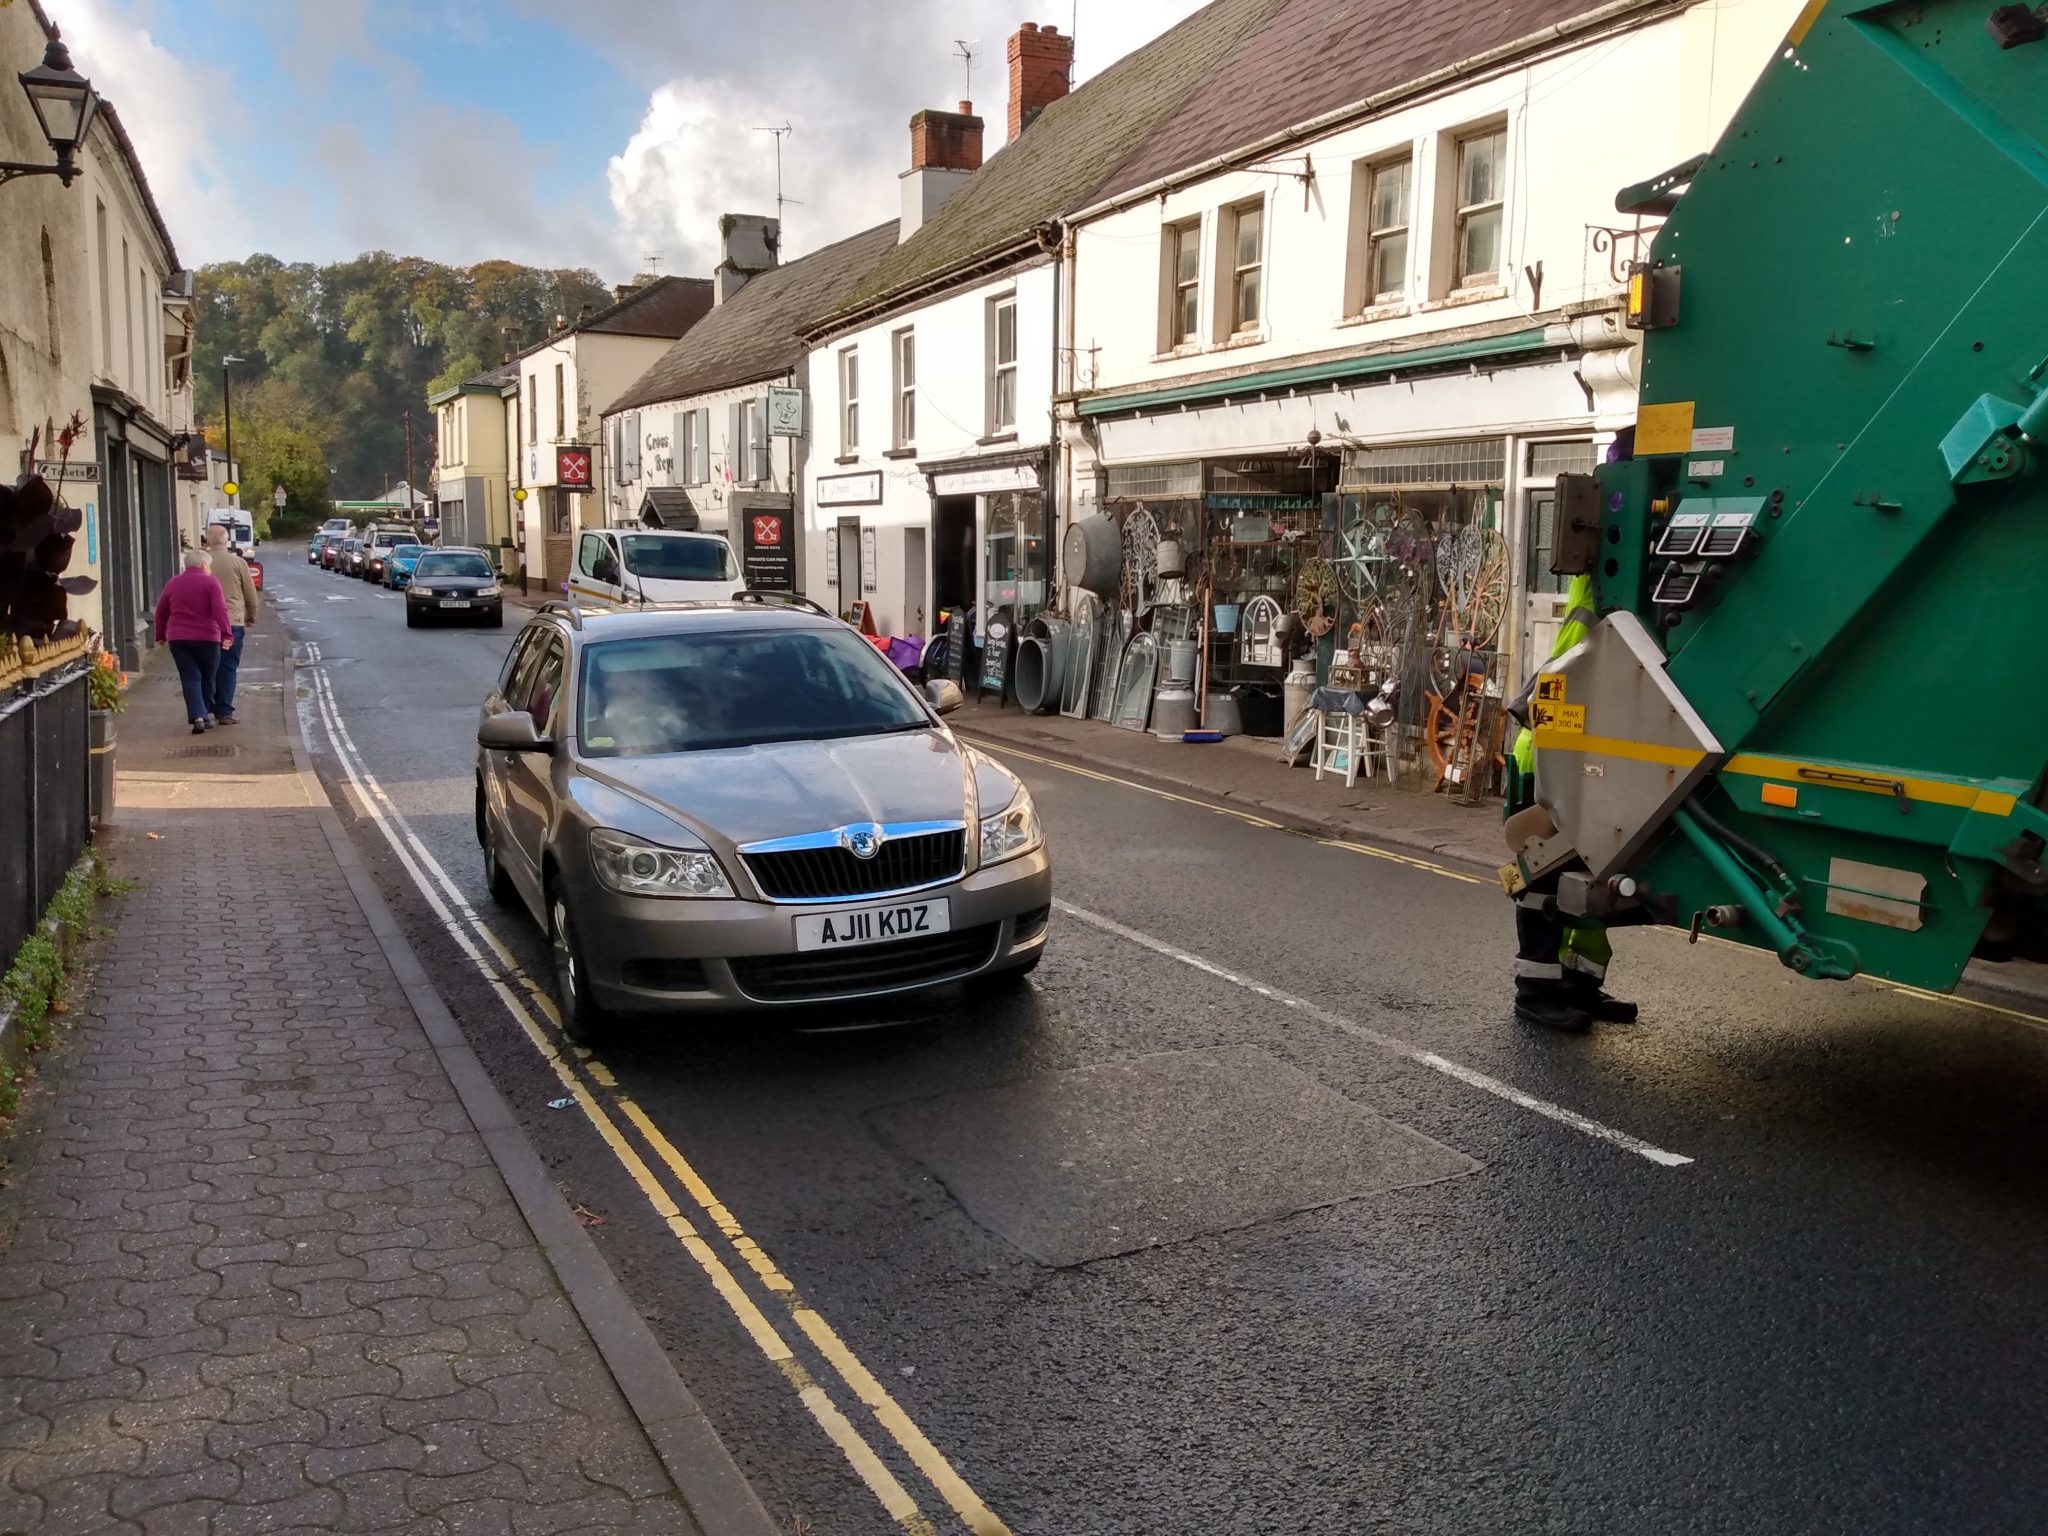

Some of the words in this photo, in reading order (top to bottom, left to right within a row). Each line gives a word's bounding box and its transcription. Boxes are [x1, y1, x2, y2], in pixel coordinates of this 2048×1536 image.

[50, 467, 86, 477] Tolets
[1562, 710, 1580, 718] MAX
[1557, 720, 1572, 728] 300
[821, 913, 872, 944] AJ11
[878, 905, 930, 937] KDZ
